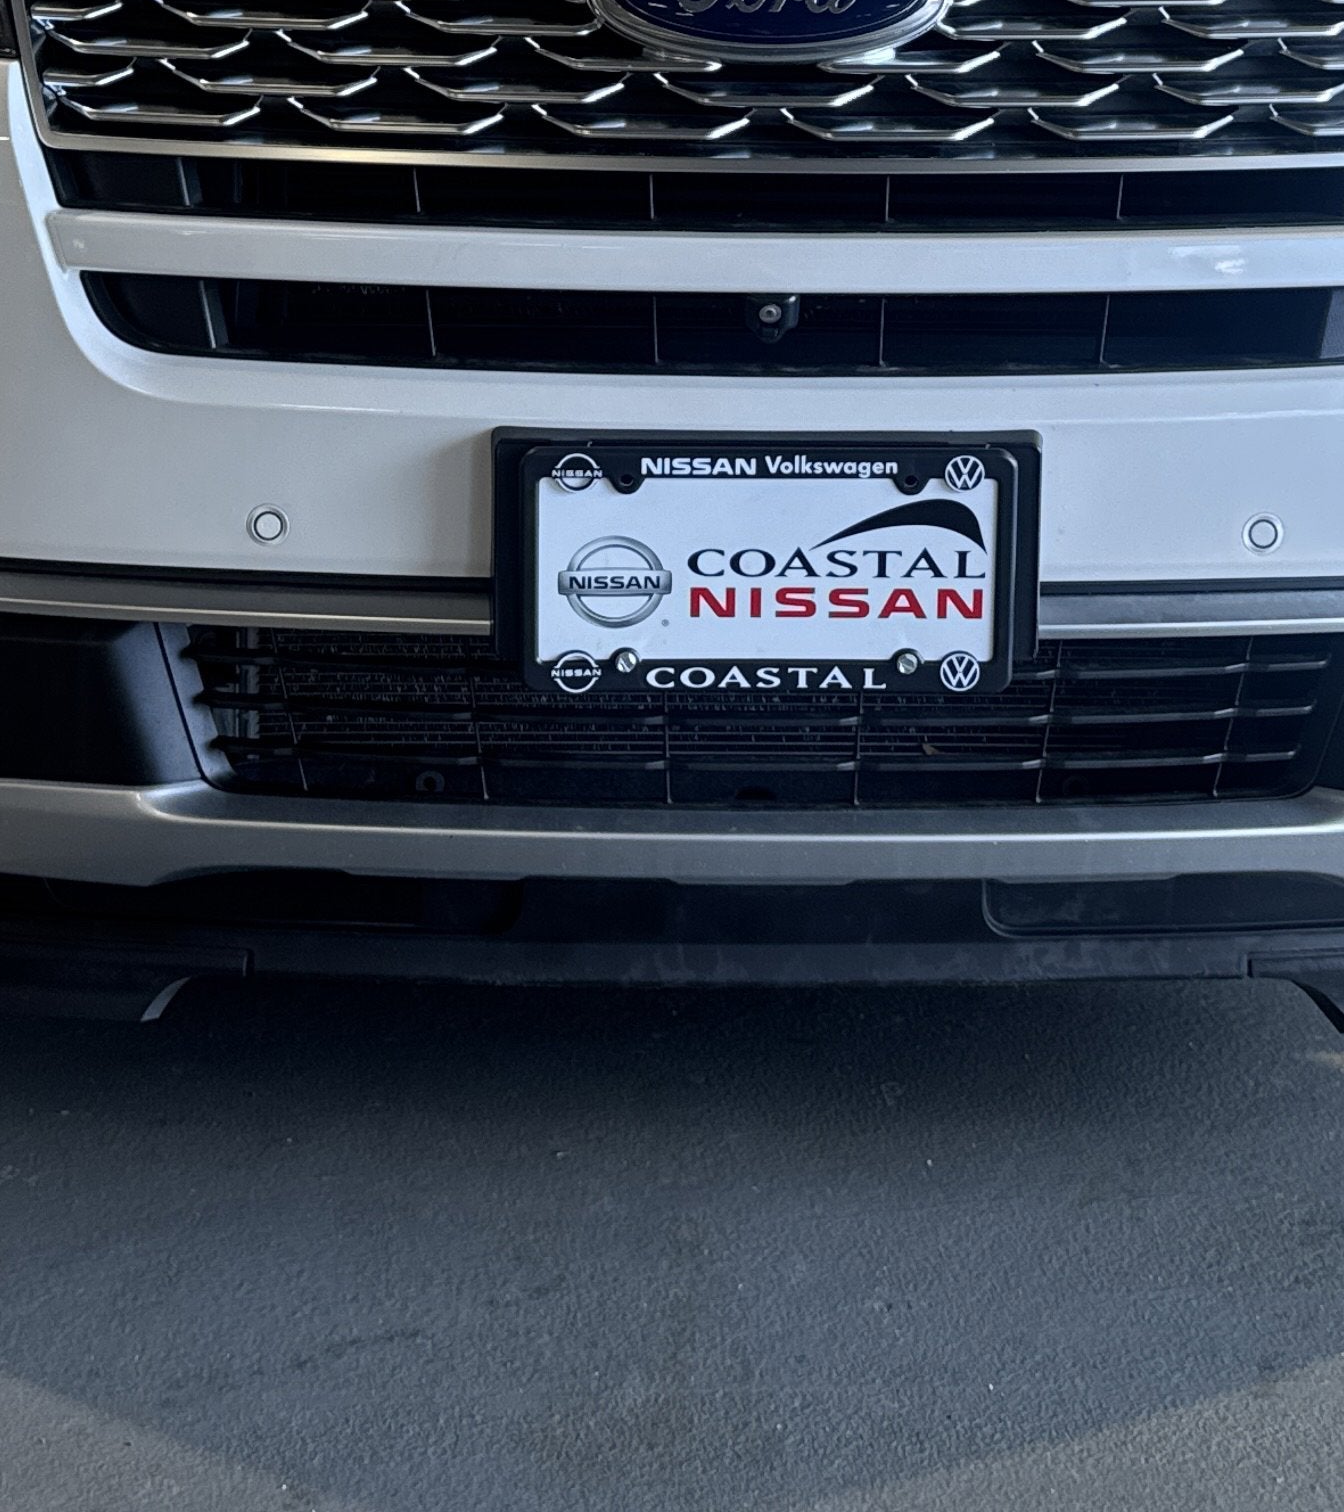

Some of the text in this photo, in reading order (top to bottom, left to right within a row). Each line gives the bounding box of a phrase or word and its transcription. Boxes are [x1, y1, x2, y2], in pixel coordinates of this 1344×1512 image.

[551, 469, 603, 478] NISSAN
[641, 454, 898, 478] NISSAN Volkswagen
[687, 547, 986, 579] COASTAL
[568, 575, 661, 590] NISSAN
[689, 587, 983, 619] NISSAN
[551, 667, 602, 678] NISSAN
[646, 665, 886, 689] COASTAL
